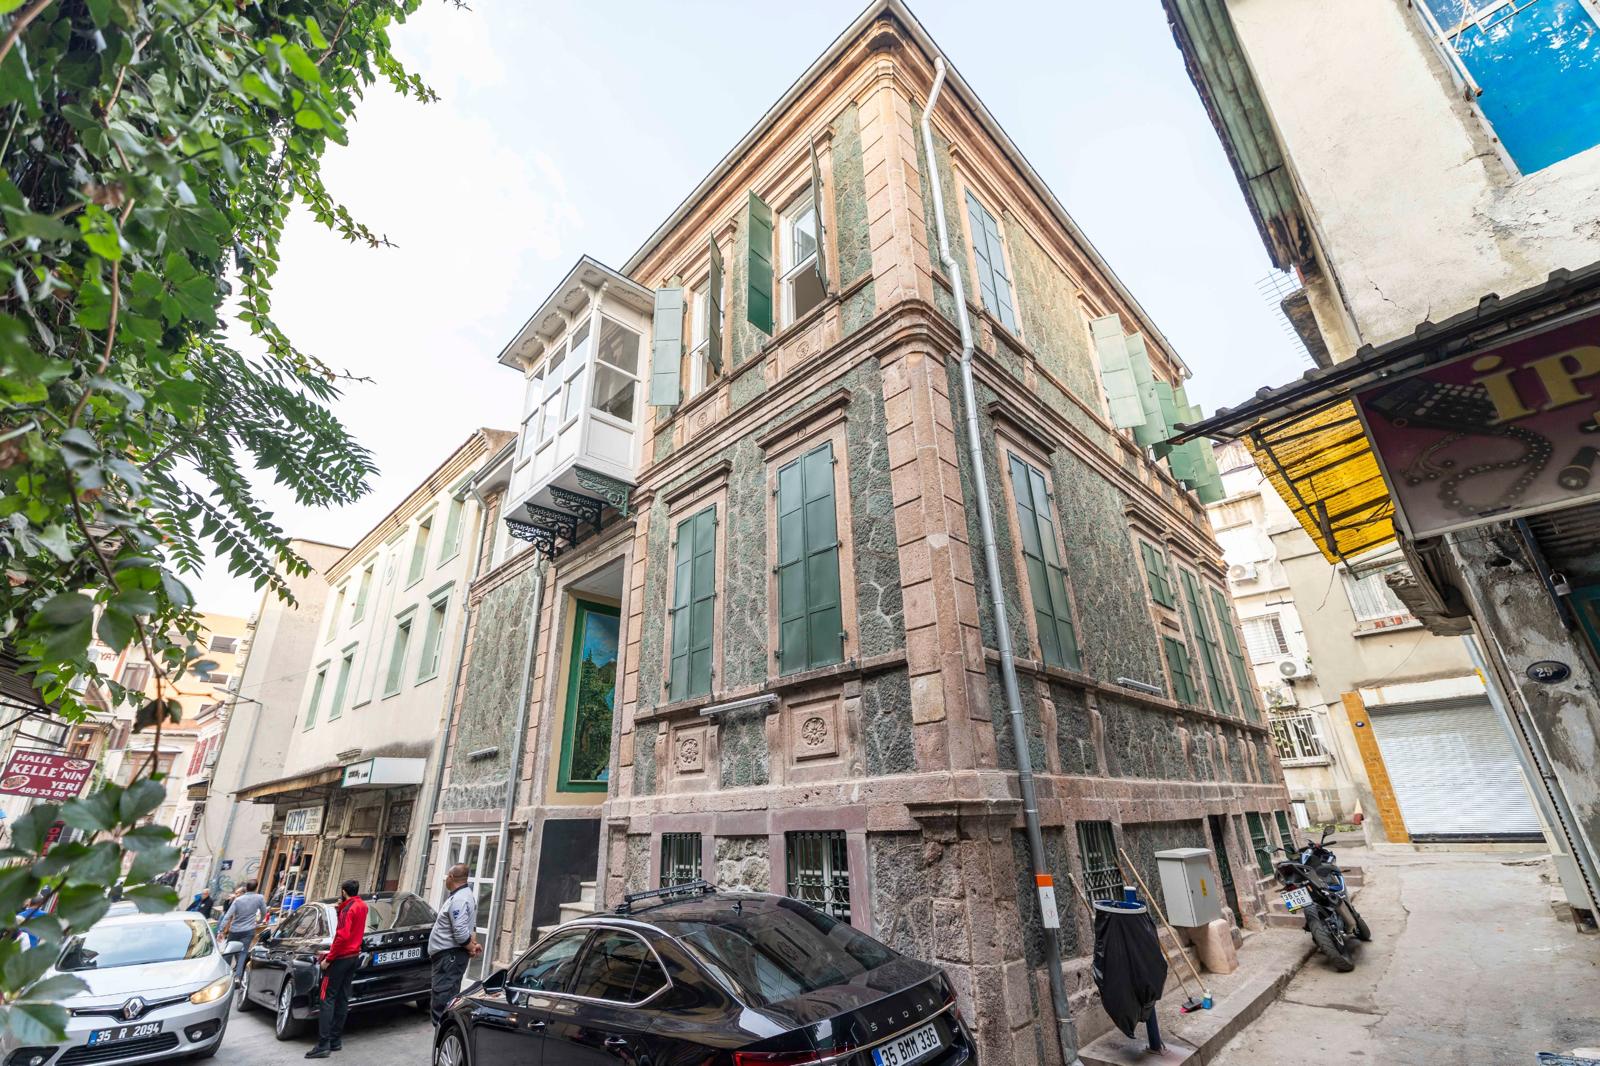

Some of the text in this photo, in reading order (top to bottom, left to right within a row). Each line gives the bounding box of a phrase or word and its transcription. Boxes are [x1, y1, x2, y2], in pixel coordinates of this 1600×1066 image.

[15, 753, 53, 765] HALİL
[9, 763, 86, 781] KELLE'NİN
[18, 786, 38, 794] 489
[38, 788, 52, 796] 33
[50, 780, 81, 791] YERİ
[188, 804, 202, 833] OTEL
[391, 951, 404, 960] CLM
[96, 1022, 160, 1042] 35 R 2094
[881, 1027, 938, 1066] 35 BMM 336
